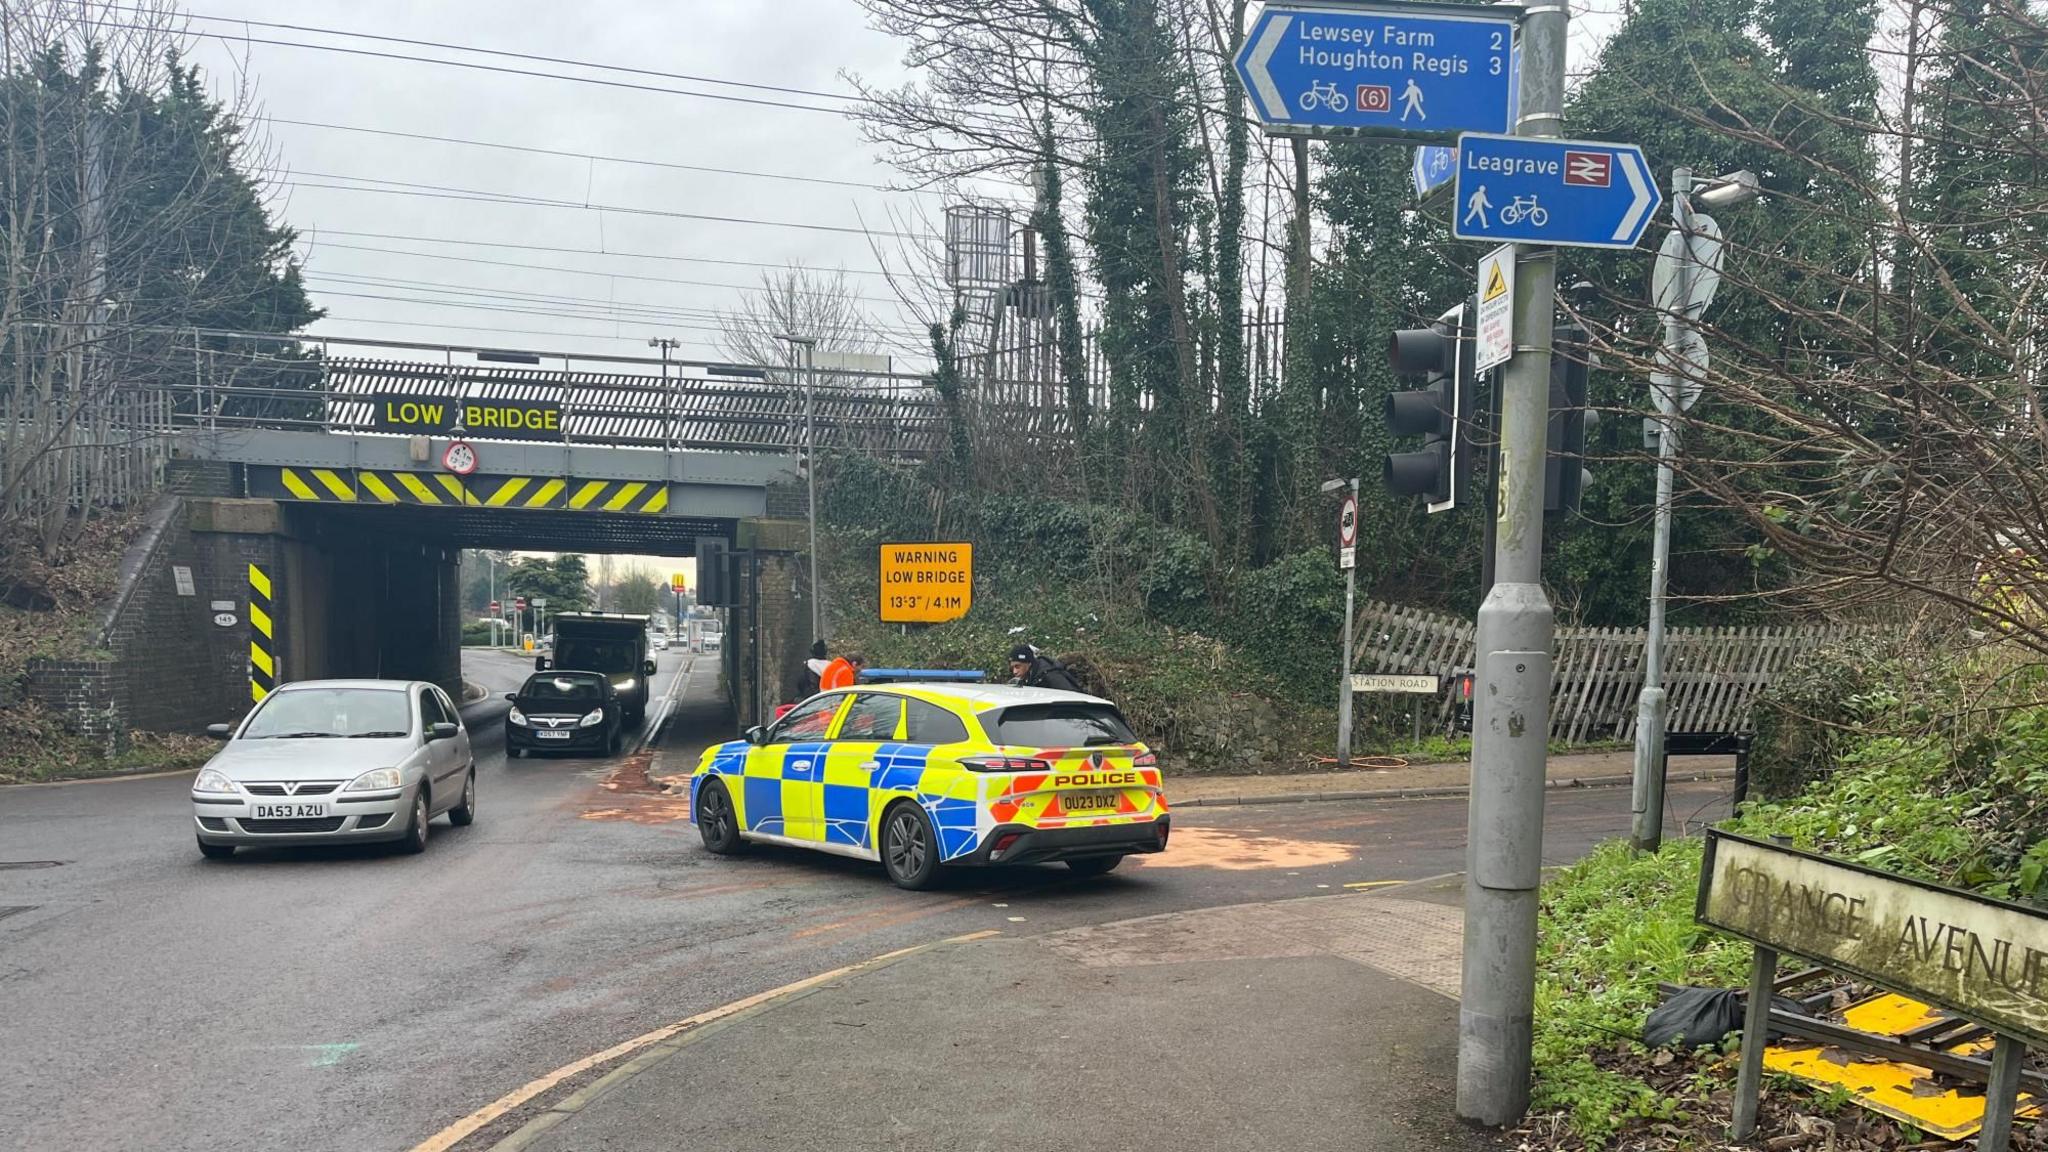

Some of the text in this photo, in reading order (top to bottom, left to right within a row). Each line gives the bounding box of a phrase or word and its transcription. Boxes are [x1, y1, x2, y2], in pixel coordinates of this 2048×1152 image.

[1300, 21, 1502, 50] Lewsey Farm 2
[1300, 46, 1501, 76] Houghton Regis 3
[1468, 151, 1559, 176] Leagrave
[387, 402, 558, 430] LOW BRIDGE
[895, 551, 957, 563] WARNING
[886, 571, 965, 583] LOW BRIDGE
[933, 597, 961, 608] 4.1M
[1353, 678, 1429, 688] STATION ROAD
[1055, 773, 1135, 786] POLICE
[1065, 795, 1116, 809] OU23 DXZ
[258, 804, 323, 817] DA53 AZU
[1732, 867, 2048, 999] GRANGE AVENUE
